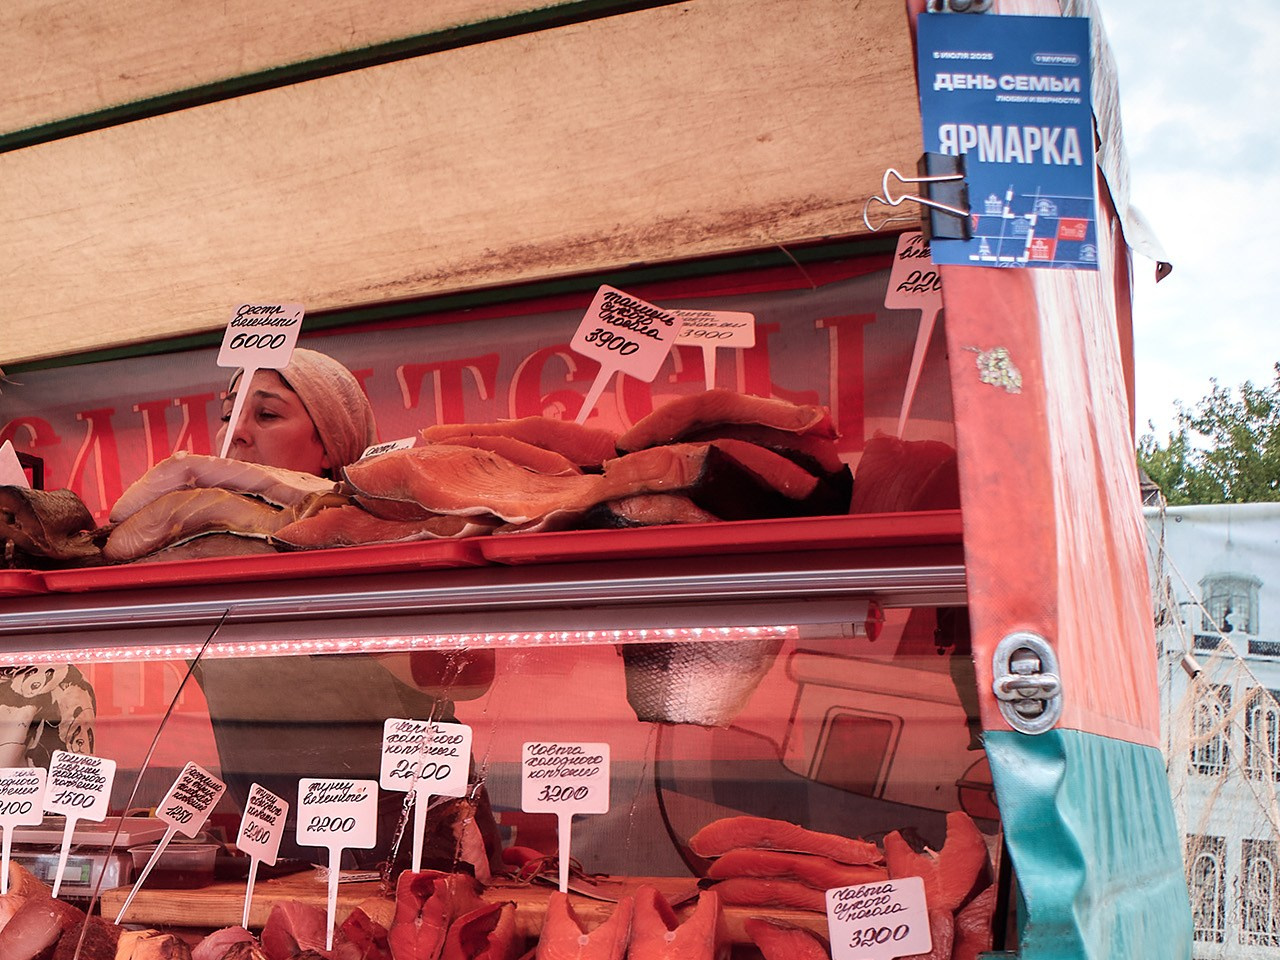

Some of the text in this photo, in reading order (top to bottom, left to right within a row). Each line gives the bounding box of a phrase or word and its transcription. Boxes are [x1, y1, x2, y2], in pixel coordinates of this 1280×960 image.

[970, 52, 994, 60] 2025
[933, 73, 1081, 93] ДЕНЬ СЕМЬИ
[1036, 96, 1081, 104] ВЕРНОСТИ
[938, 123, 1083, 166] ЯРМАРКА
[896, 270, 942, 293] 220
[229, 333, 287, 350] 6000
[584, 327, 640, 356] 3900
[679, 328, 734, 340] 3900
[524, 755, 604, 769] холодного
[527, 766, 600, 779] копчения
[51, 789, 96, 809] 1500
[537, 784, 589, 803] 3200
[165, 804, 194, 824] 1250
[306, 816, 356, 833] 2200
[848, 923, 910, 949] 3200
